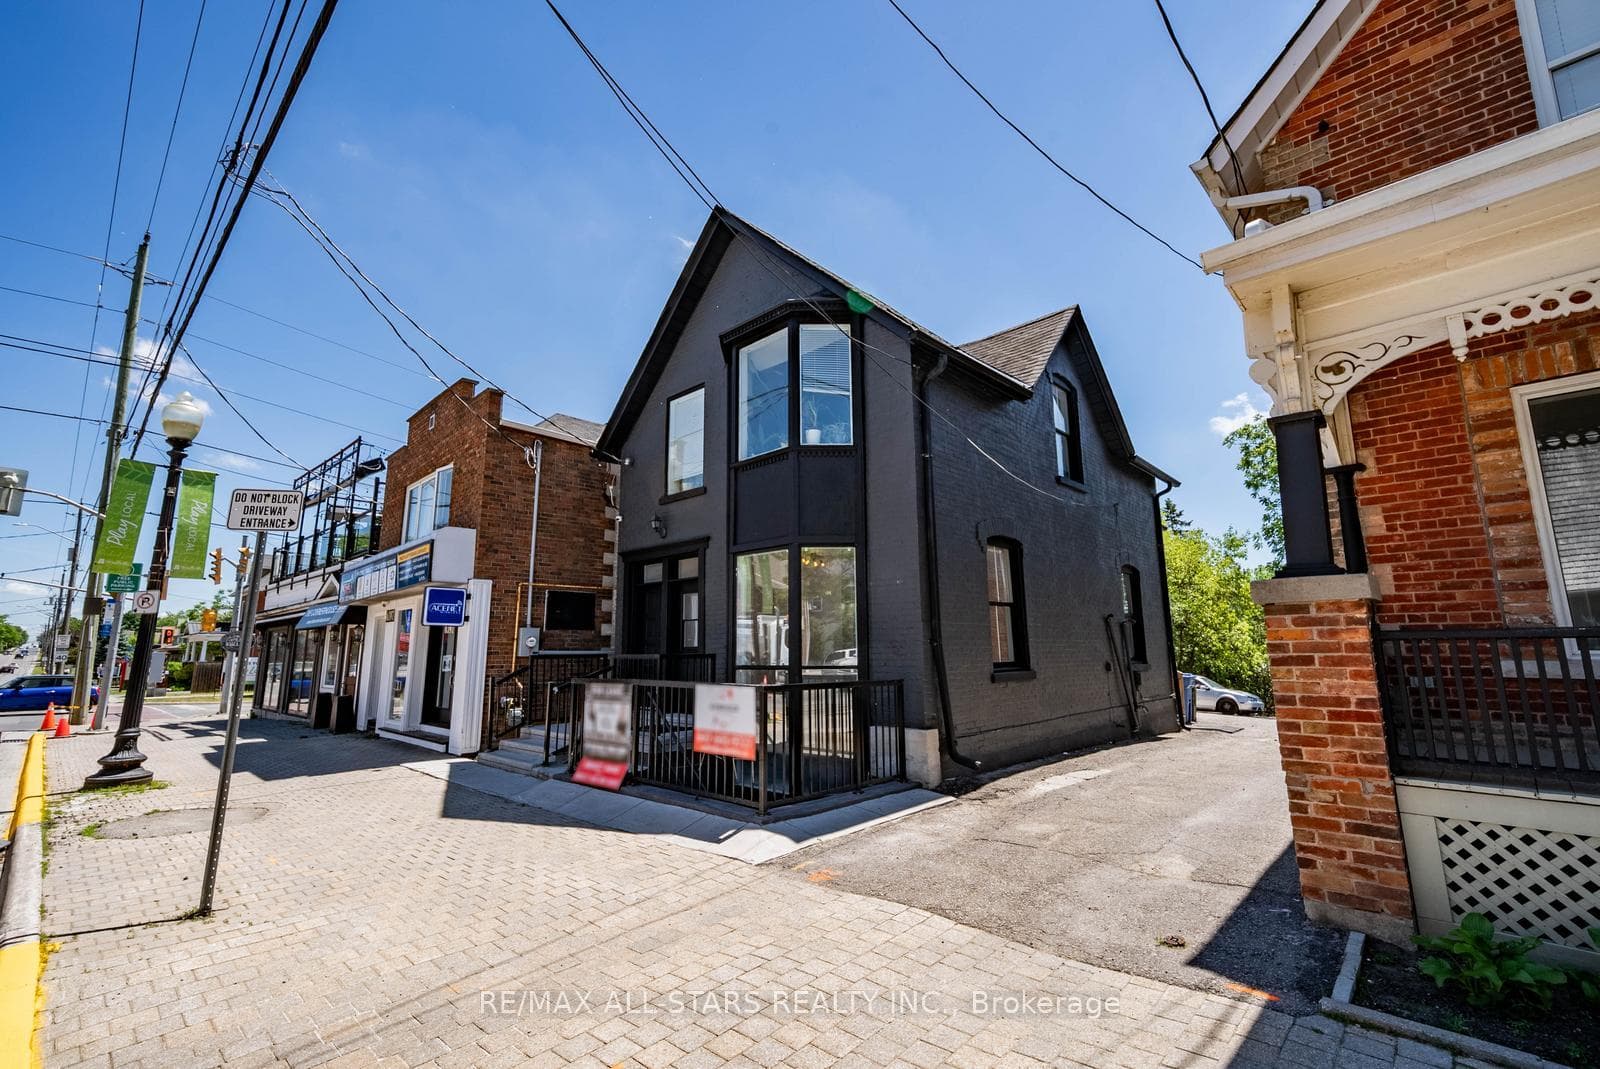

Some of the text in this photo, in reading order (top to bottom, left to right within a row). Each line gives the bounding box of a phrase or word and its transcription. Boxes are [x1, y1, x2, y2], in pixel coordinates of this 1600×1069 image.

[235, 493, 299, 504] DO NOT BLOCK
[182, 498, 208, 525] Play
[243, 505, 288, 516] DRIVEWAY
[107, 519, 138, 546] Play
[124, 492, 137, 518] LOCAL
[240, 518, 286, 528] ENTRANCE
[185, 526, 199, 552] LOCAL
[56, 653, 67, 661] 40
